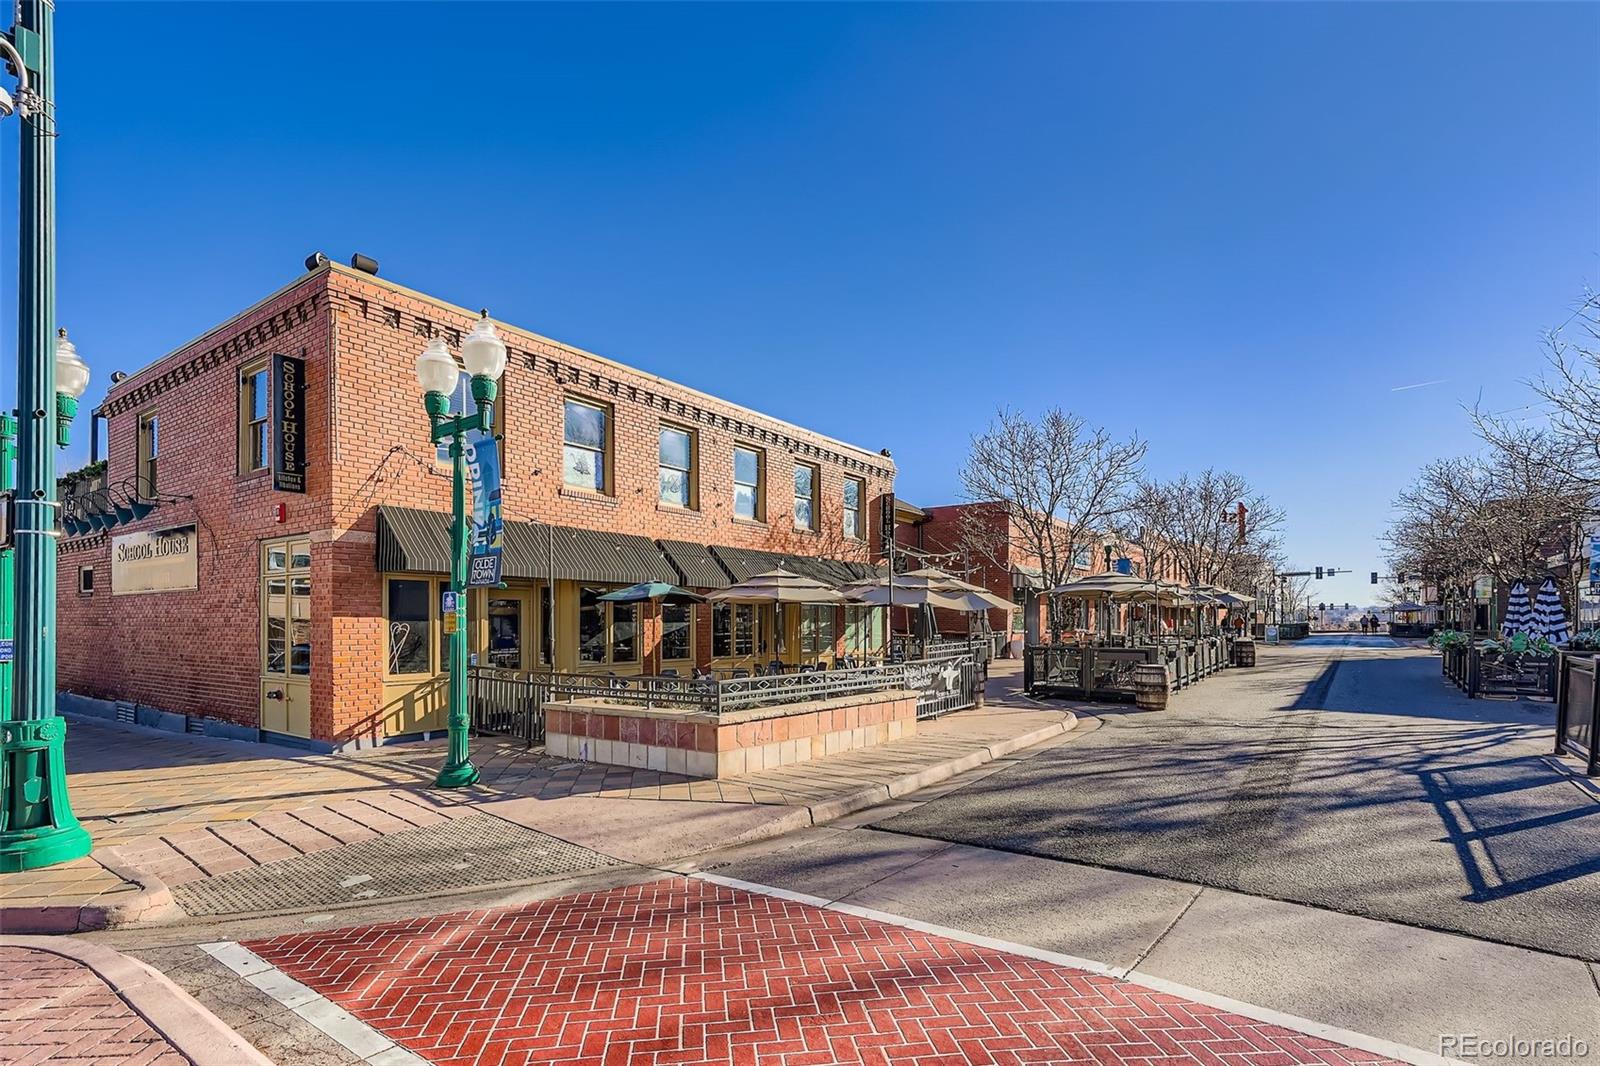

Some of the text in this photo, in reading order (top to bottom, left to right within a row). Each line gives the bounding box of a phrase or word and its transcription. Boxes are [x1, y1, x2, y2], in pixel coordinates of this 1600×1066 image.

[282, 361, 298, 471] SCHOOL HOUSE
[117, 535, 189, 563] SCHOOL HOUSE
[475, 558, 494, 570] OLDE
[473, 569, 494, 580] TOWN
